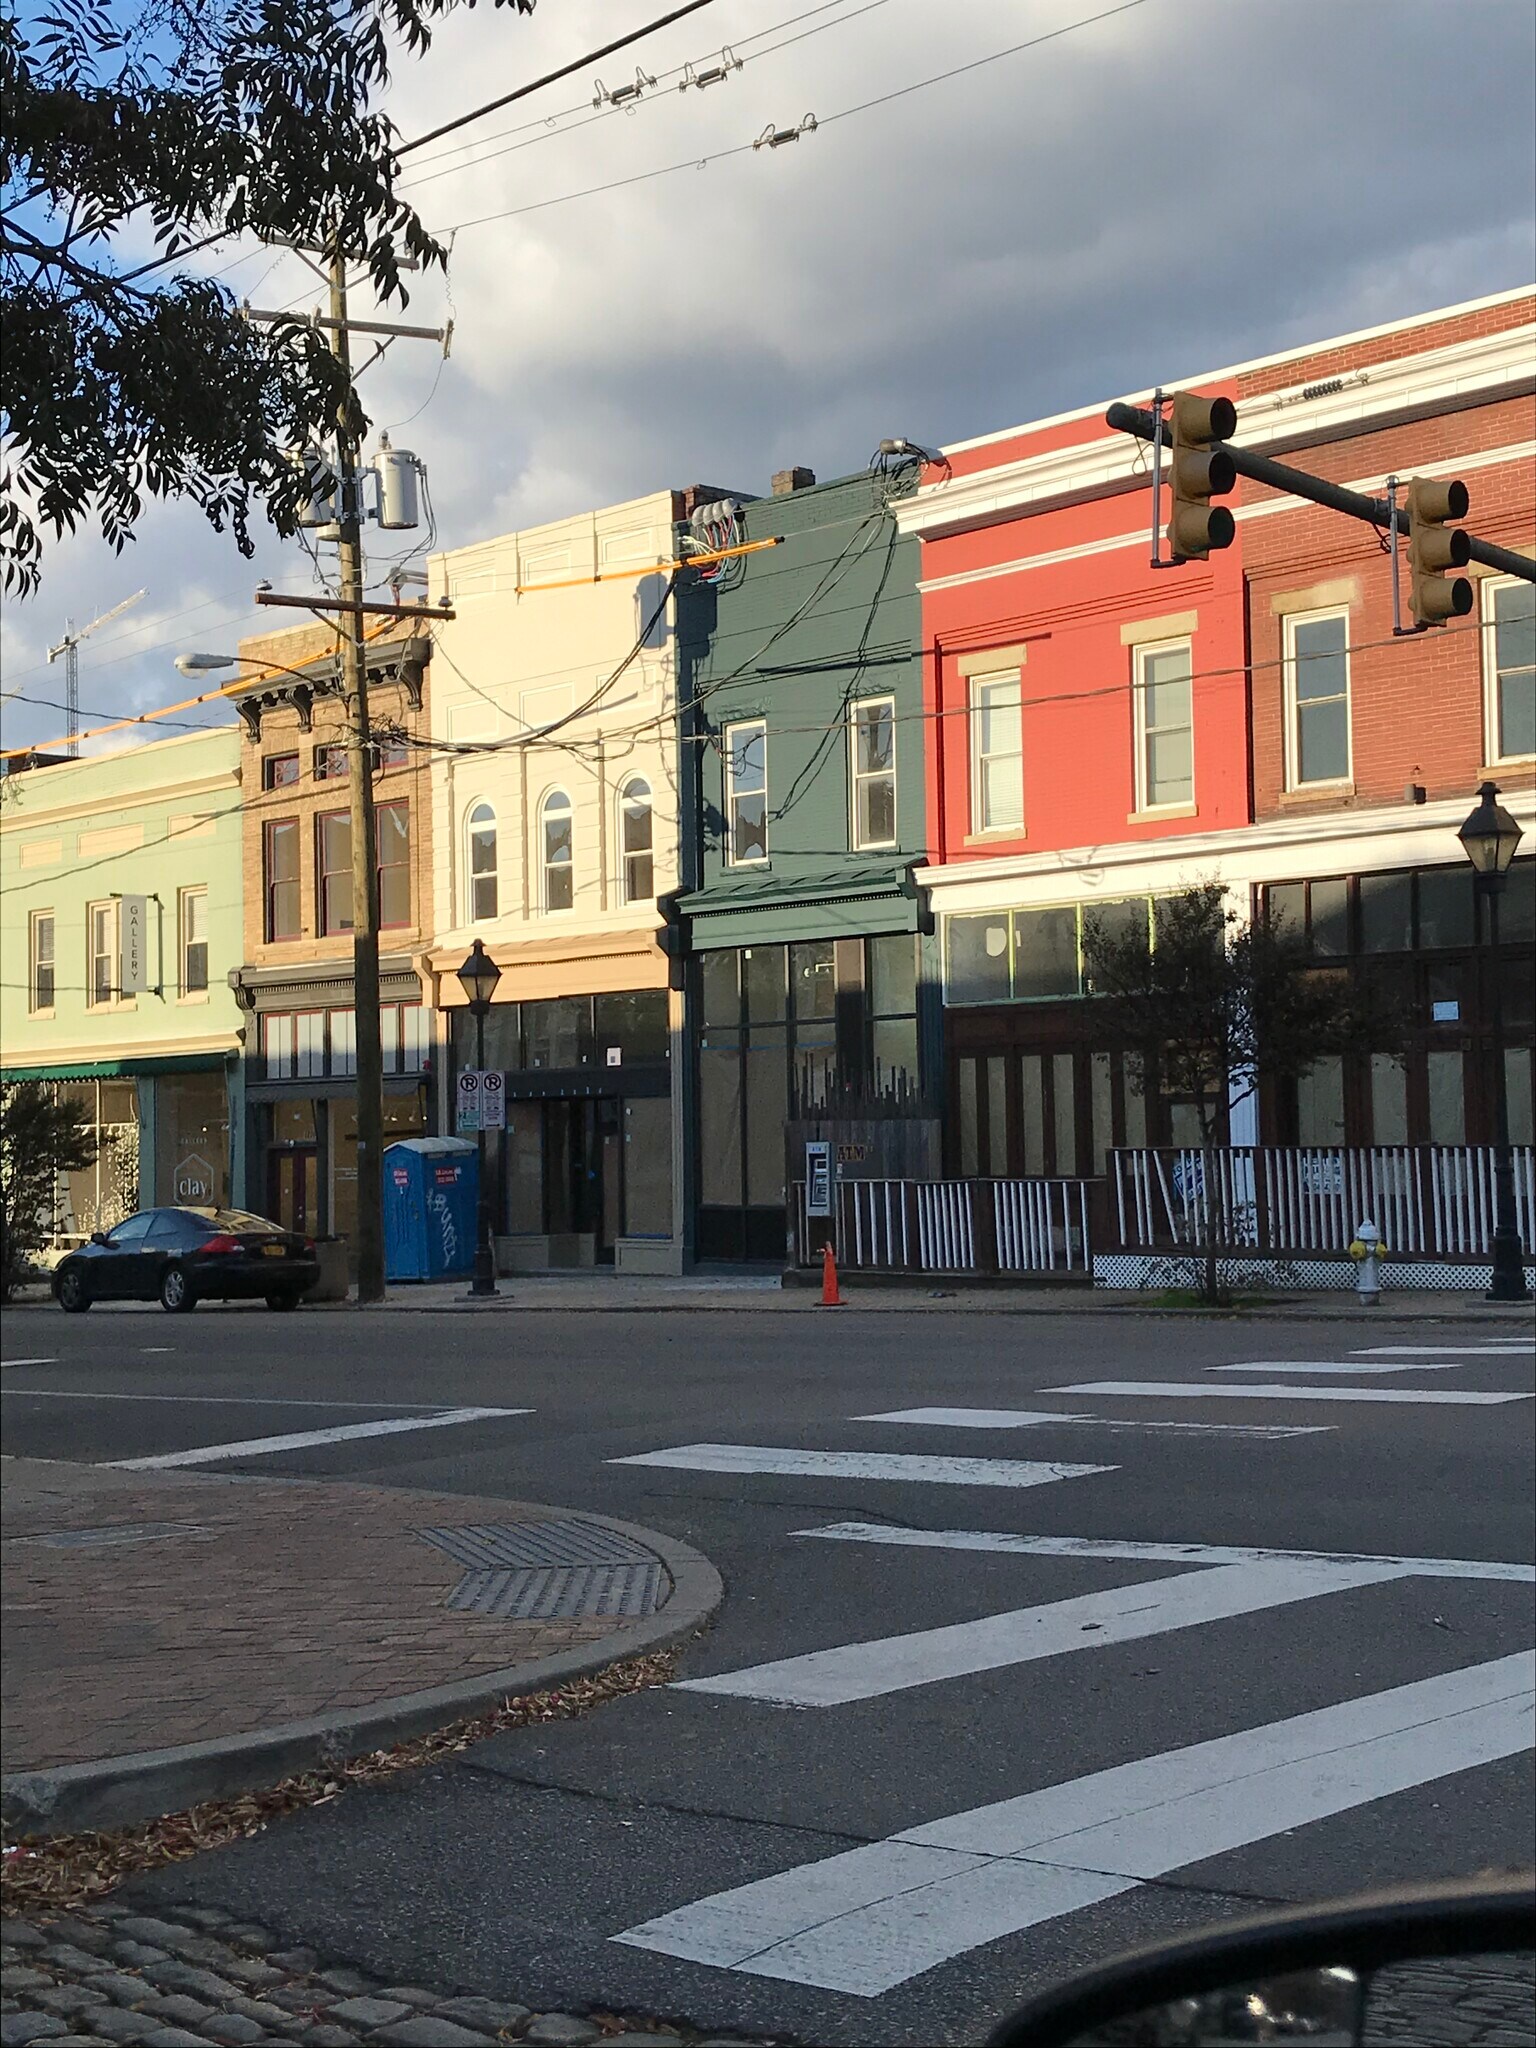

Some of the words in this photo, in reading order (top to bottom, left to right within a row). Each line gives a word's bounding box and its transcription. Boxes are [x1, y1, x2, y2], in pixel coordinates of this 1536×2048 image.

[130, 905, 139, 981] GALLERY
[836, 1145, 866, 1161] ATM
[179, 1177, 207, 1200] clay
